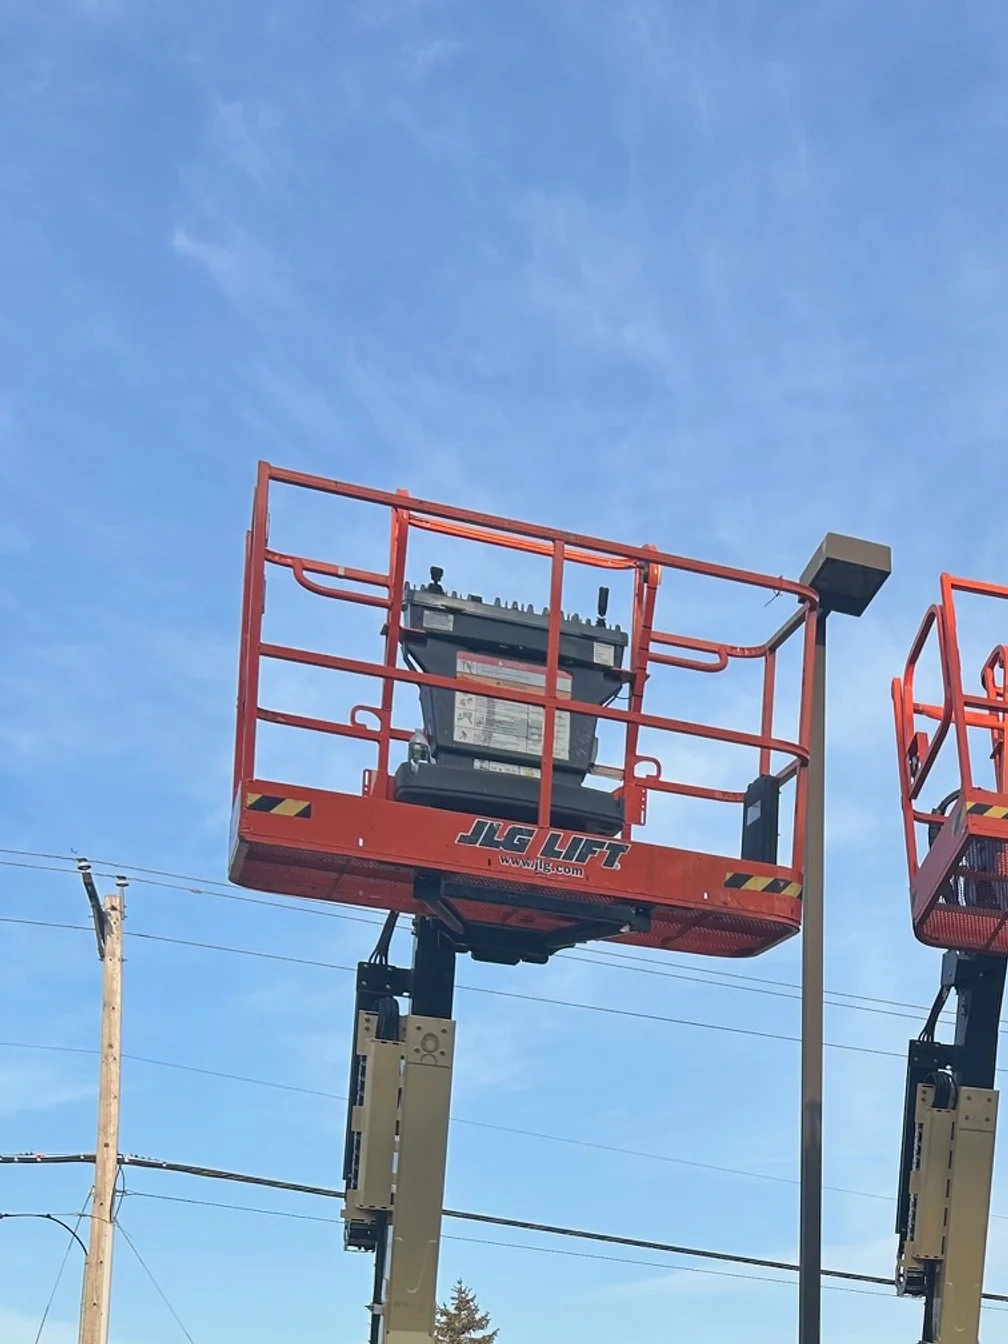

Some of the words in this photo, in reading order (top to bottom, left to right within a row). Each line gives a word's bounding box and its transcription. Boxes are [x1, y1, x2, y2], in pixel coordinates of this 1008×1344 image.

[455, 818, 539, 855] JLG
[537, 830, 632, 869] LIFT
[499, 855, 584, 878] www.jlg.com
